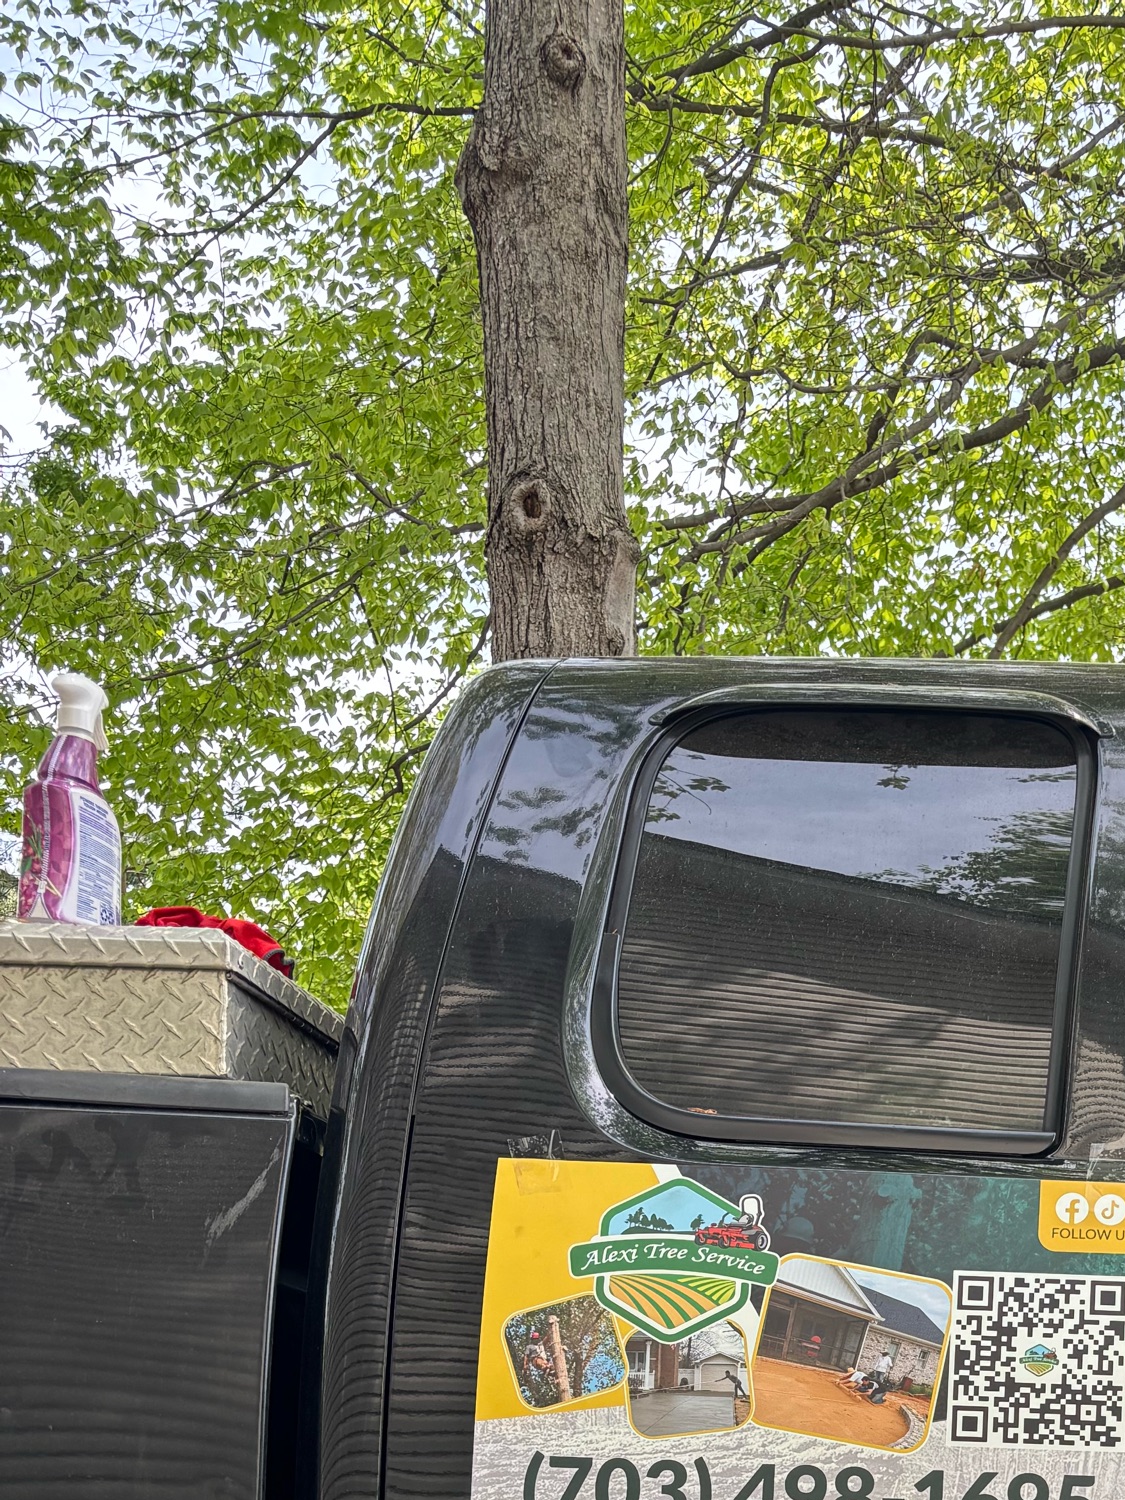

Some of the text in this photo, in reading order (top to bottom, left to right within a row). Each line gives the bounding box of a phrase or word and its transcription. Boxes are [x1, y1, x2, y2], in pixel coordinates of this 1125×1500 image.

[1051, 1227, 1112, 1241] FOLLOW
[580, 1242, 766, 1275] Alexi Tree Service
